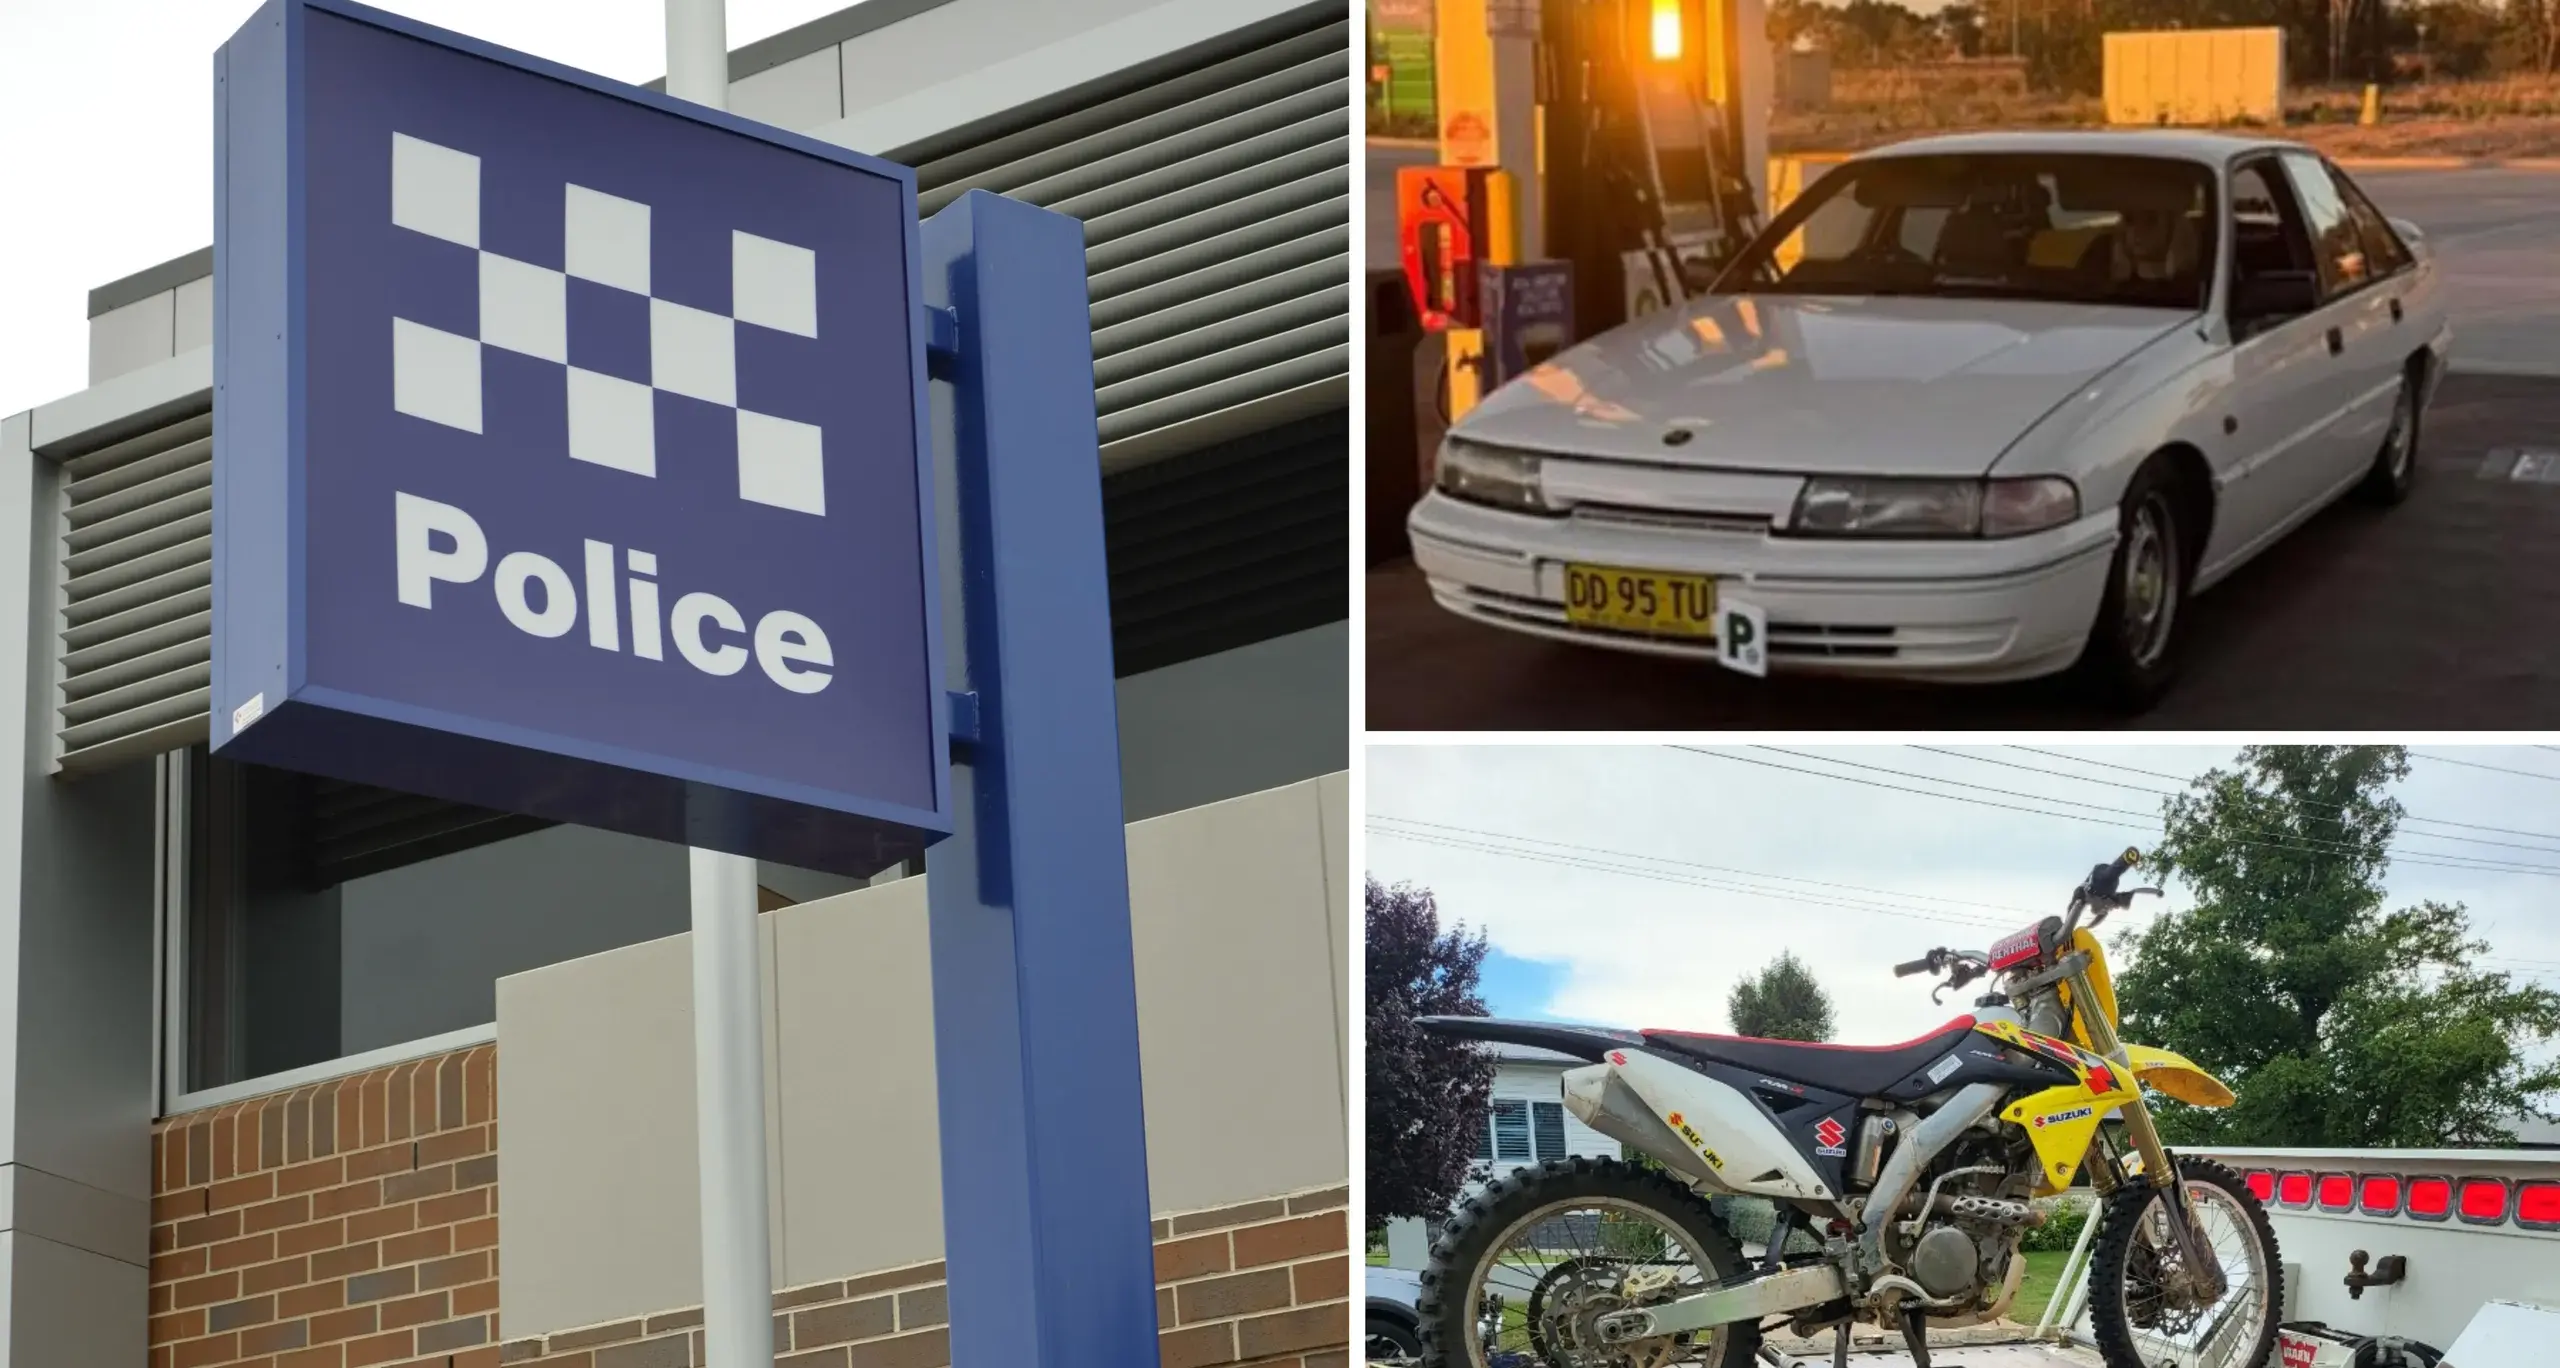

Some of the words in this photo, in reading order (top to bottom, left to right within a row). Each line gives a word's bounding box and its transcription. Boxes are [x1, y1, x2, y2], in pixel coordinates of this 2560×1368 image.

[396, 490, 834, 694] Police
[1570, 571, 1609, 611] DD
[1617, 576, 1657, 617] 95
[1667, 581, 1708, 622] TU
[1727, 612, 1755, 660] P
[2047, 1107, 2092, 1123] SUZUKI
